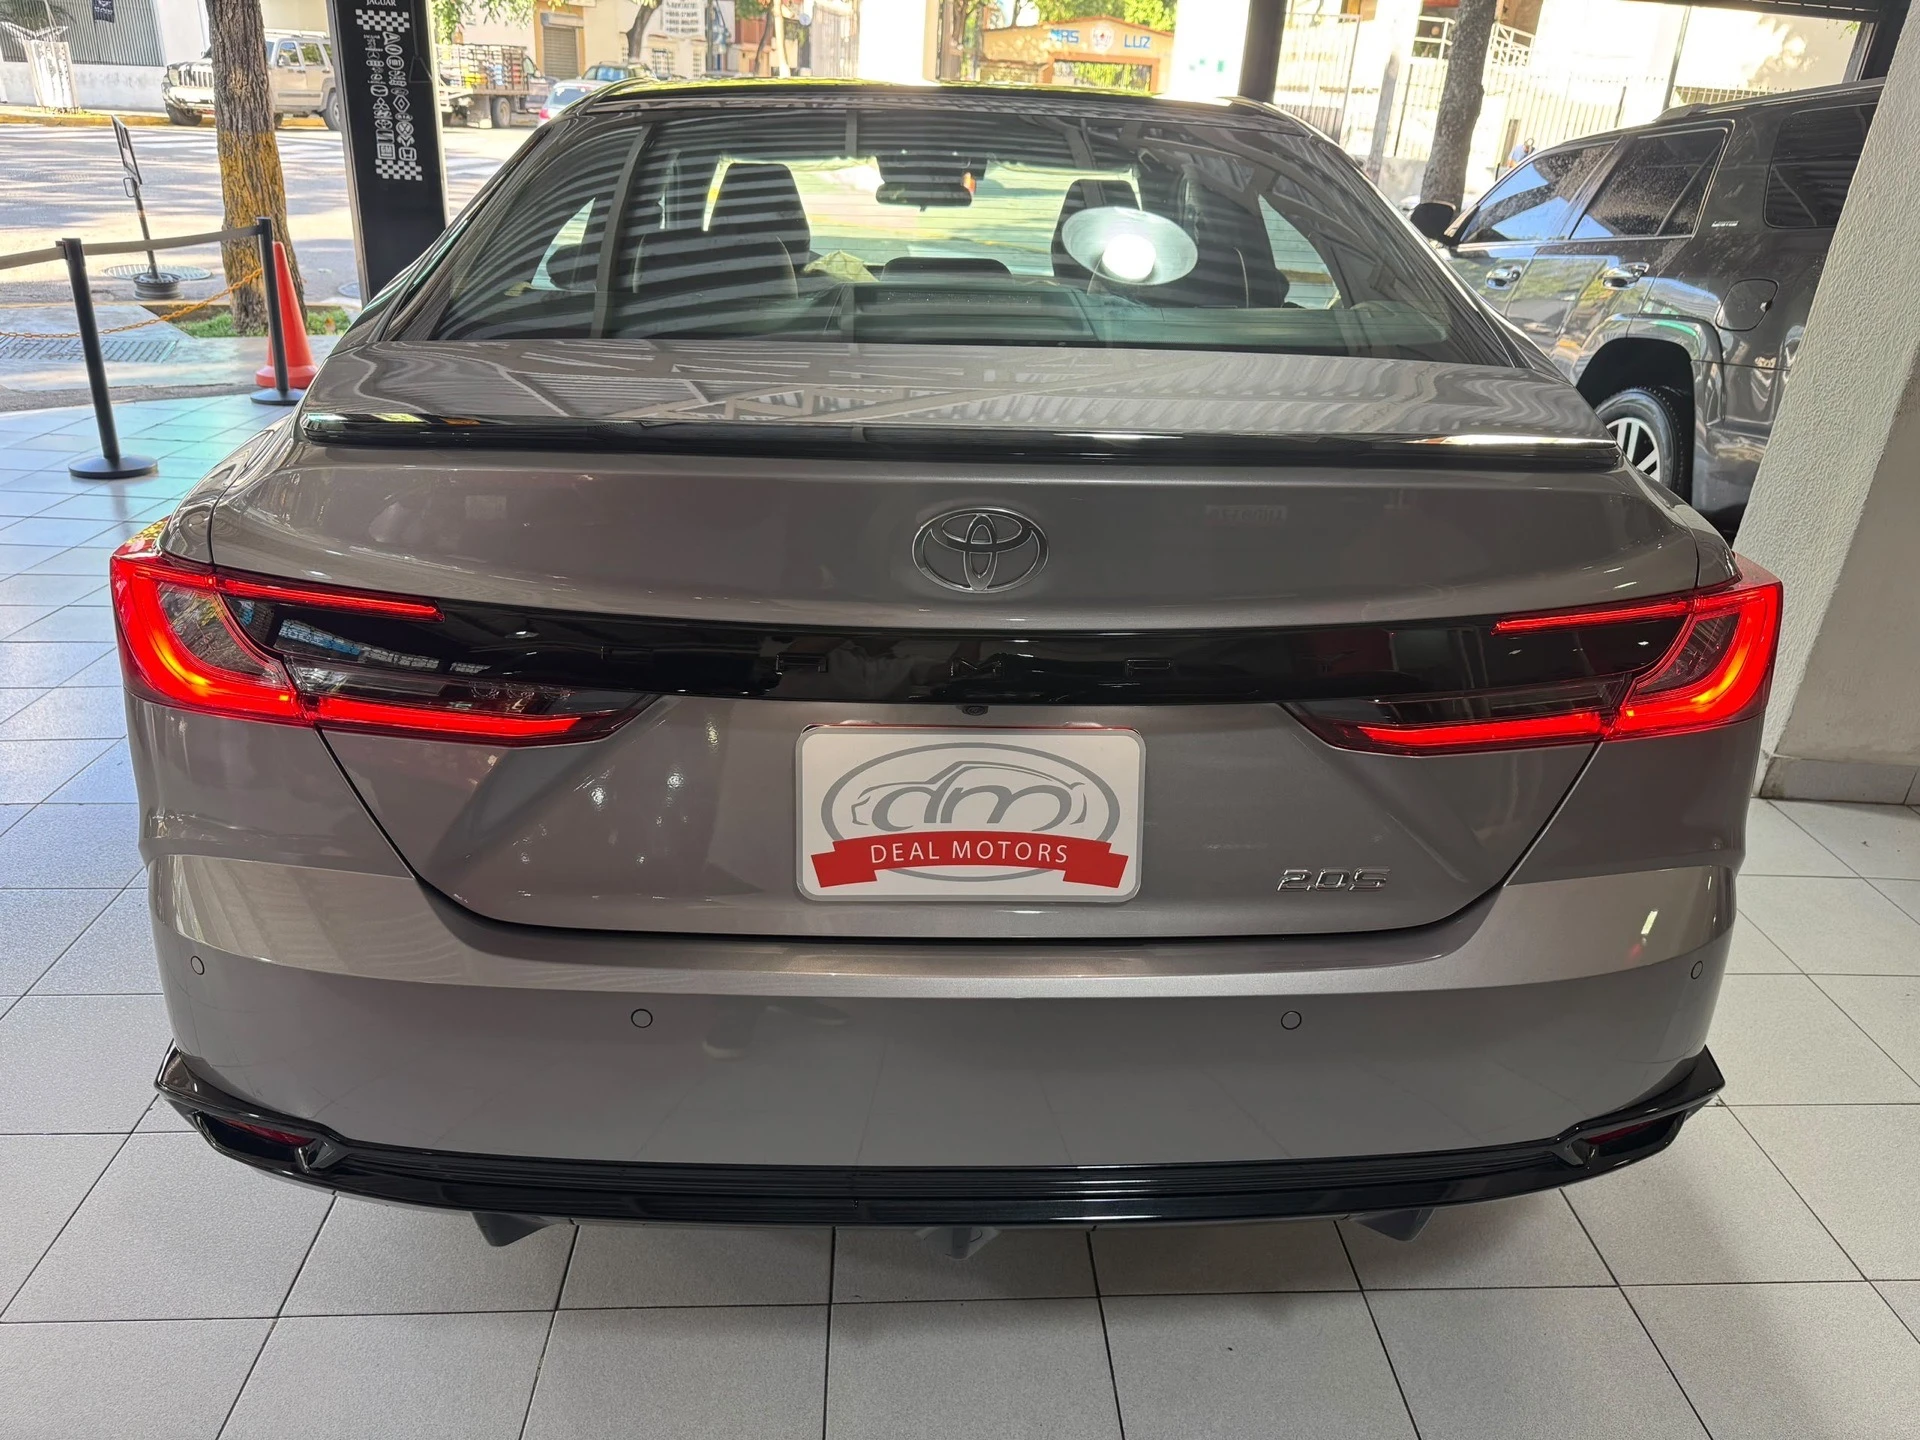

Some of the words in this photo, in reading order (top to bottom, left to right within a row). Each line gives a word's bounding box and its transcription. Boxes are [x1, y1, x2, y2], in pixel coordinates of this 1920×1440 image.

[1124, 34, 1151, 49] LUZ
[870, 841, 940, 864] DEAL
[952, 840, 1068, 864] MOTORS
